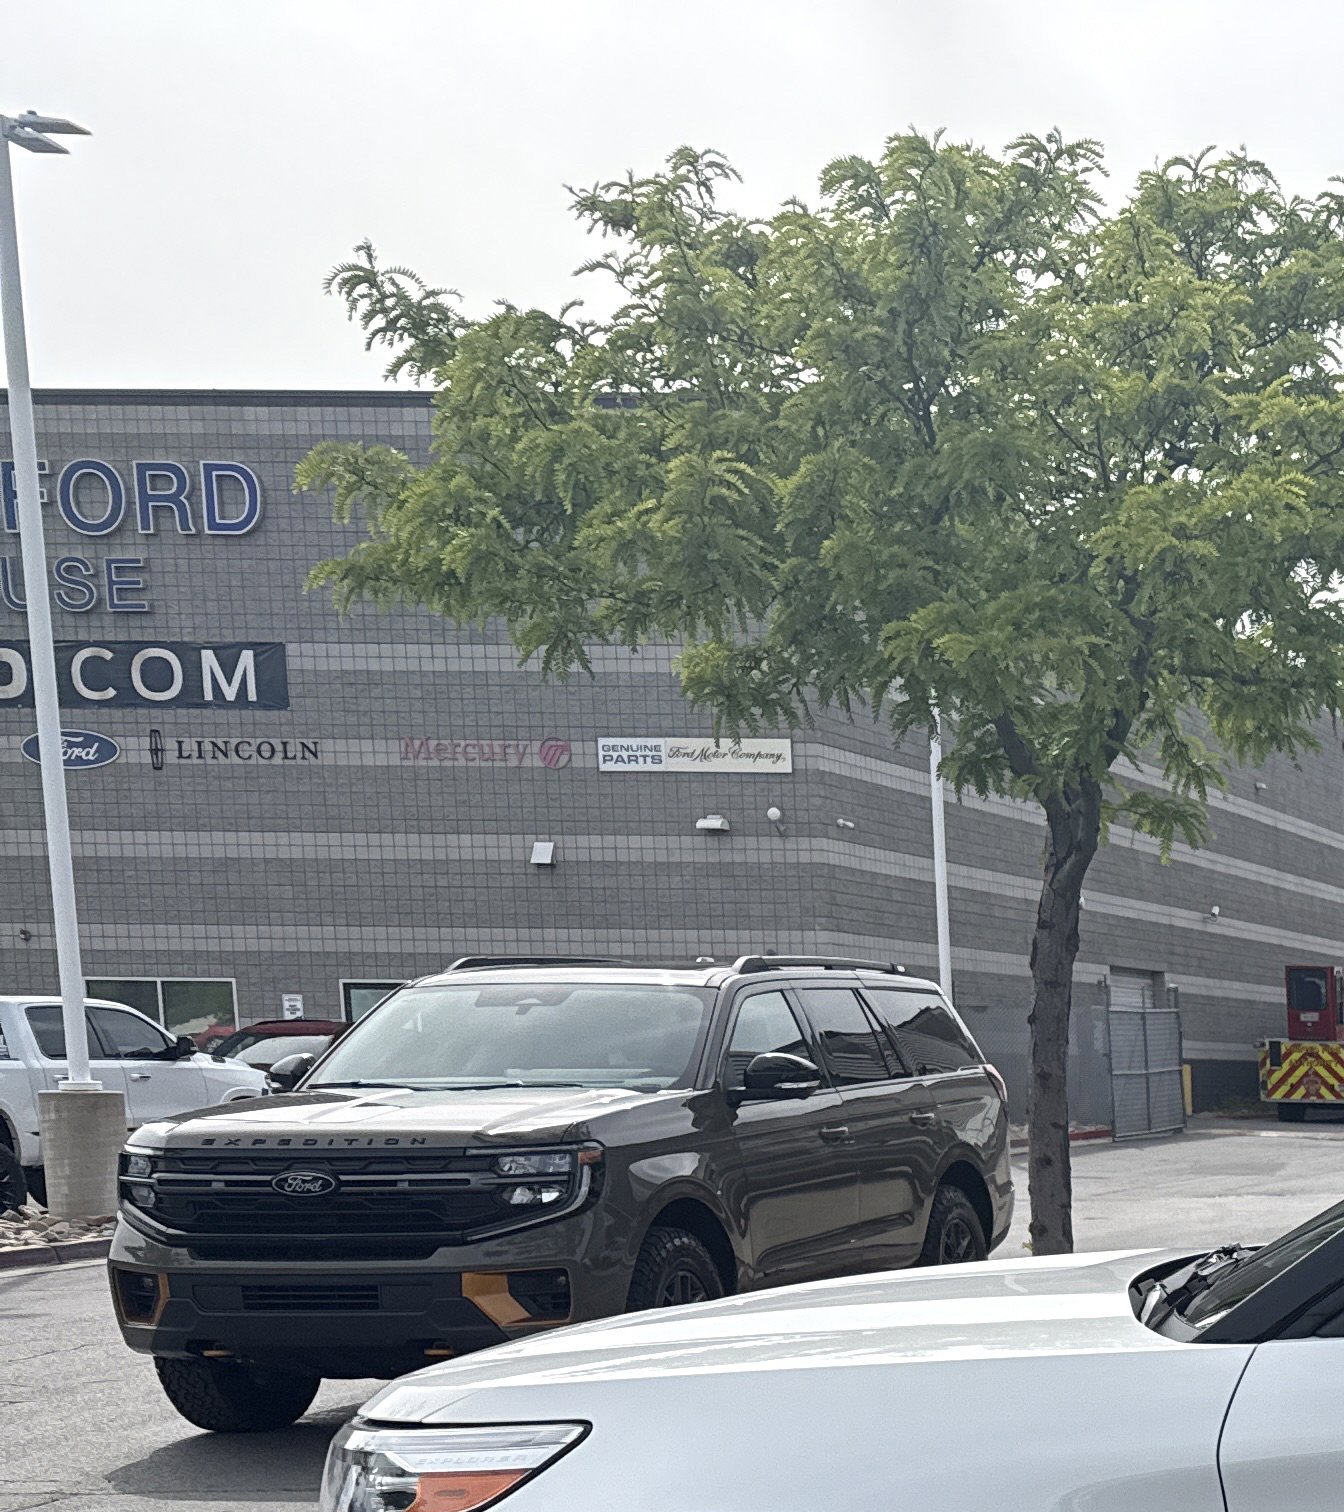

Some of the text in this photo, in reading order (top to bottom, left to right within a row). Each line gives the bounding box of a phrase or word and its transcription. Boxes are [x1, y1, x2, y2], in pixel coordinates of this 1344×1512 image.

[175, 739, 320, 761] LINCOLN
[400, 736, 530, 768] Mercury
[601, 744, 662, 753] GENUINE
[667, 745, 696, 759] Ford
[691, 746, 729, 762] Motor
[602, 754, 663, 765] PARTS
[201, 1137, 427, 1146] EXPEDITION
[284, 1175, 324, 1193] Ford
[415, 1454, 529, 1467] EXPLORER
